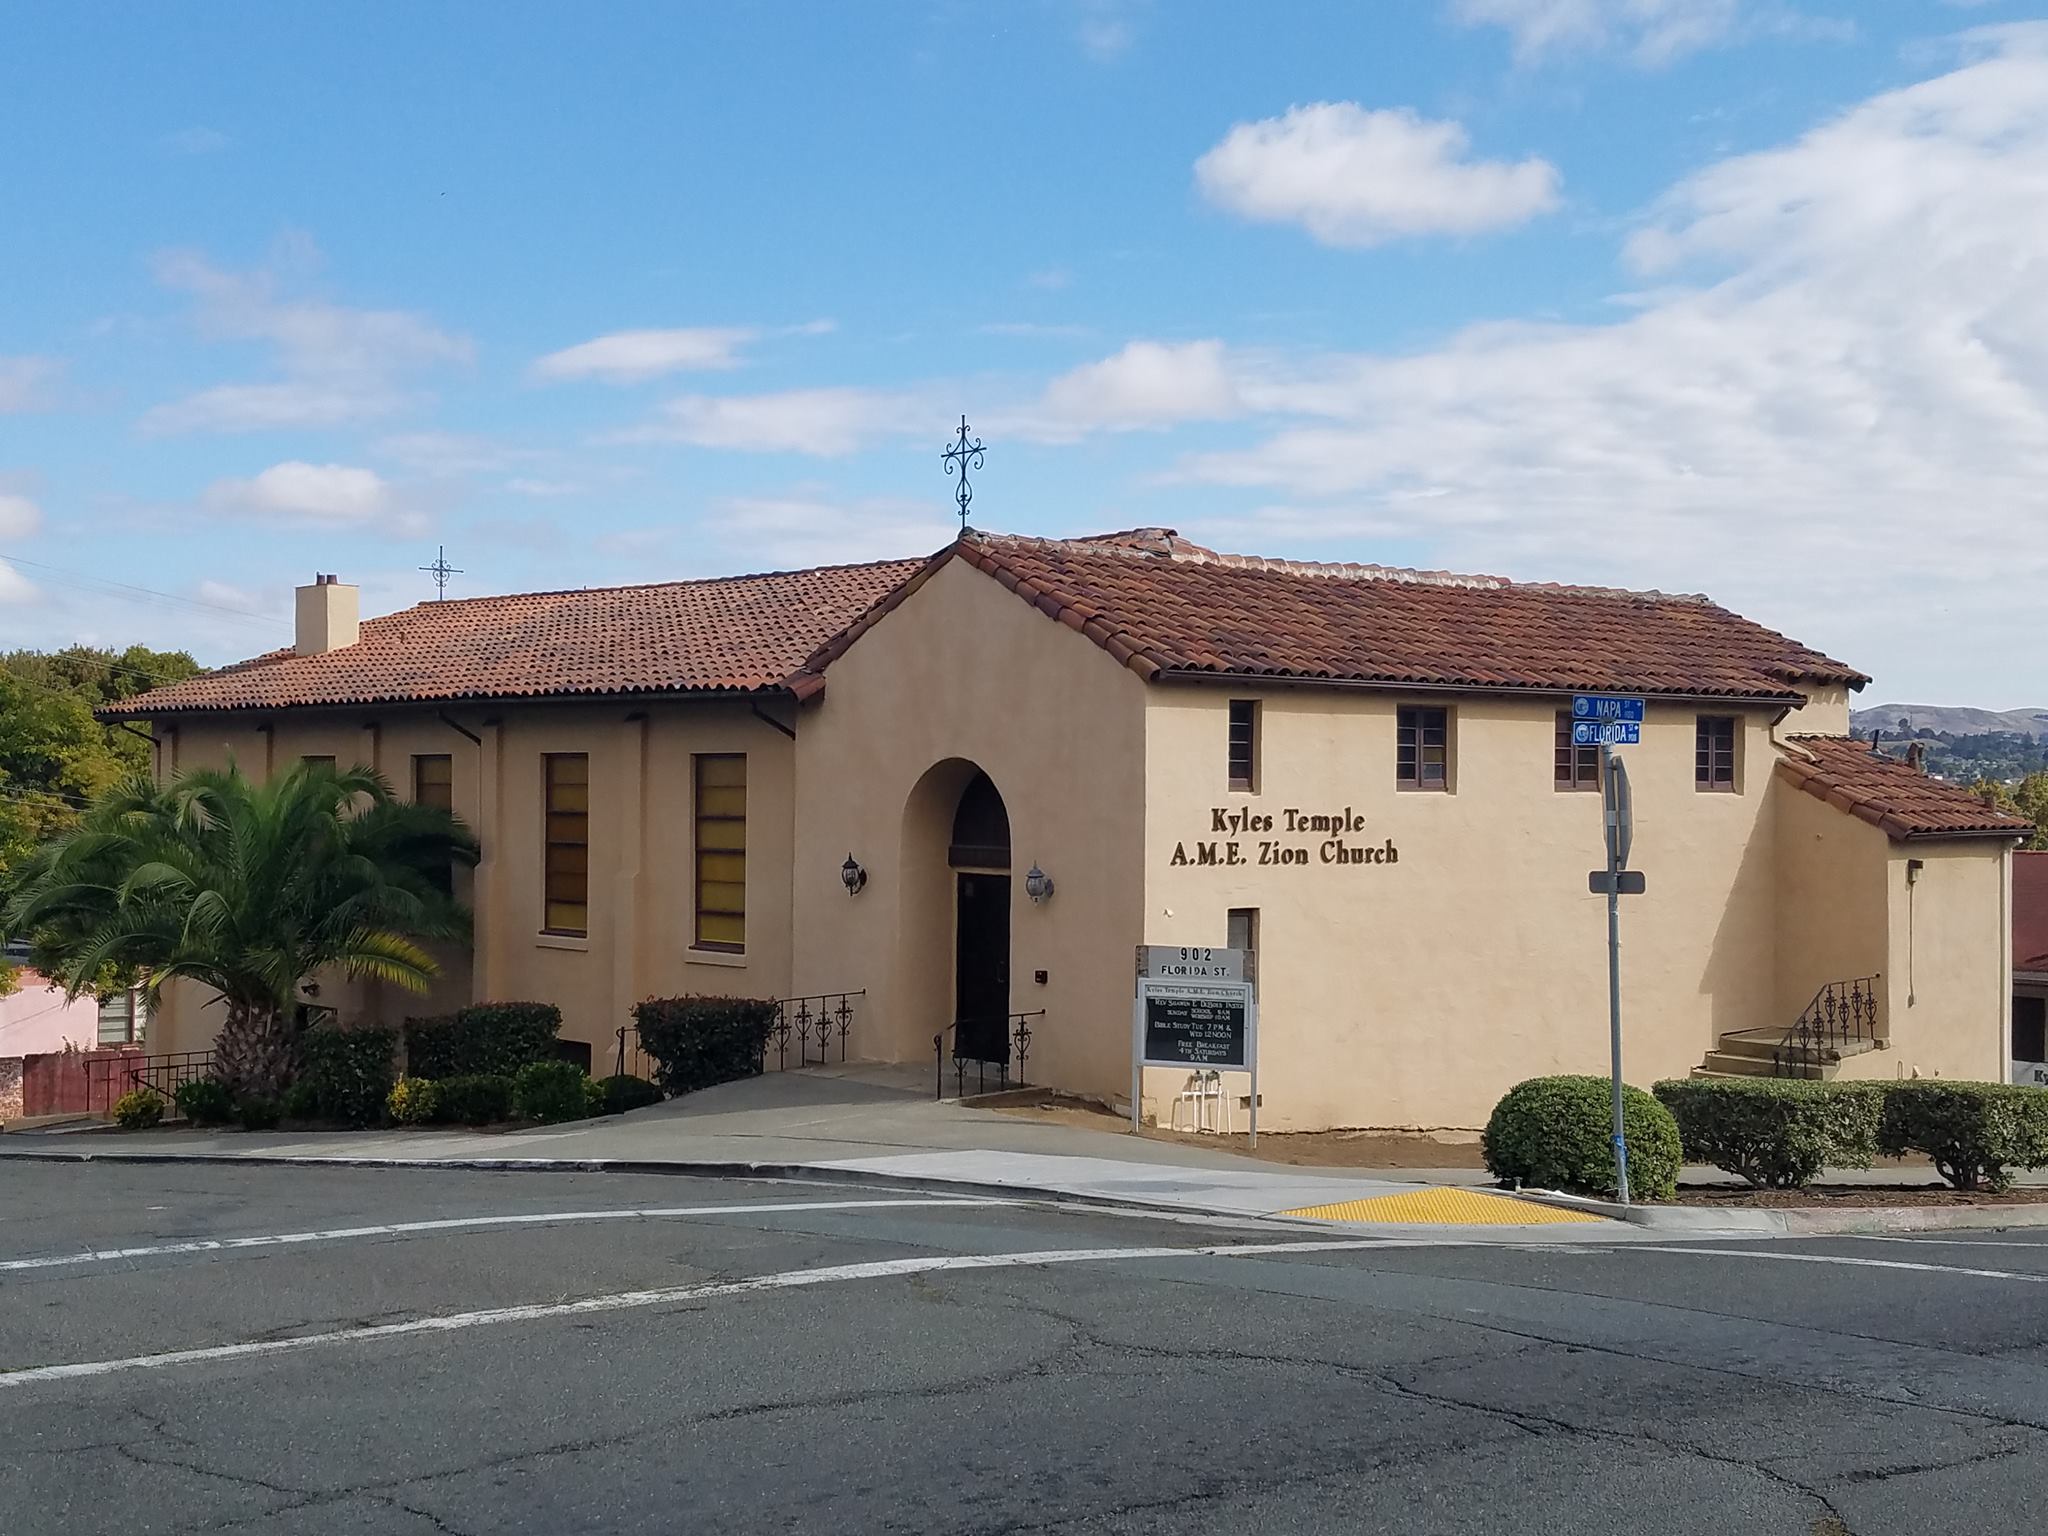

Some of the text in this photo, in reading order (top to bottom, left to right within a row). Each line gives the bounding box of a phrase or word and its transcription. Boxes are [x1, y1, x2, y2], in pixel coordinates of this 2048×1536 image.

[1596, 700, 1621, 717] NAPA
[1589, 725, 1627, 741] FLORIDA
[1211, 806, 1365, 838] Kyles Temple
[1170, 838, 1399, 865] A.M.E. Zion Church
[1181, 947, 1211, 961] 902
[1161, 965, 1230, 976] FLORIDA ST.
[1165, 987, 1184, 995] Temple
[1154, 1021, 1171, 1029] BIBLE
[1172, 1021, 1190, 1030] STUDY
[1191, 1022, 1203, 1030] TUE
[1189, 1030, 1203, 1038] WED
[1177, 1040, 1230, 1050] FREE BREAKFAST
